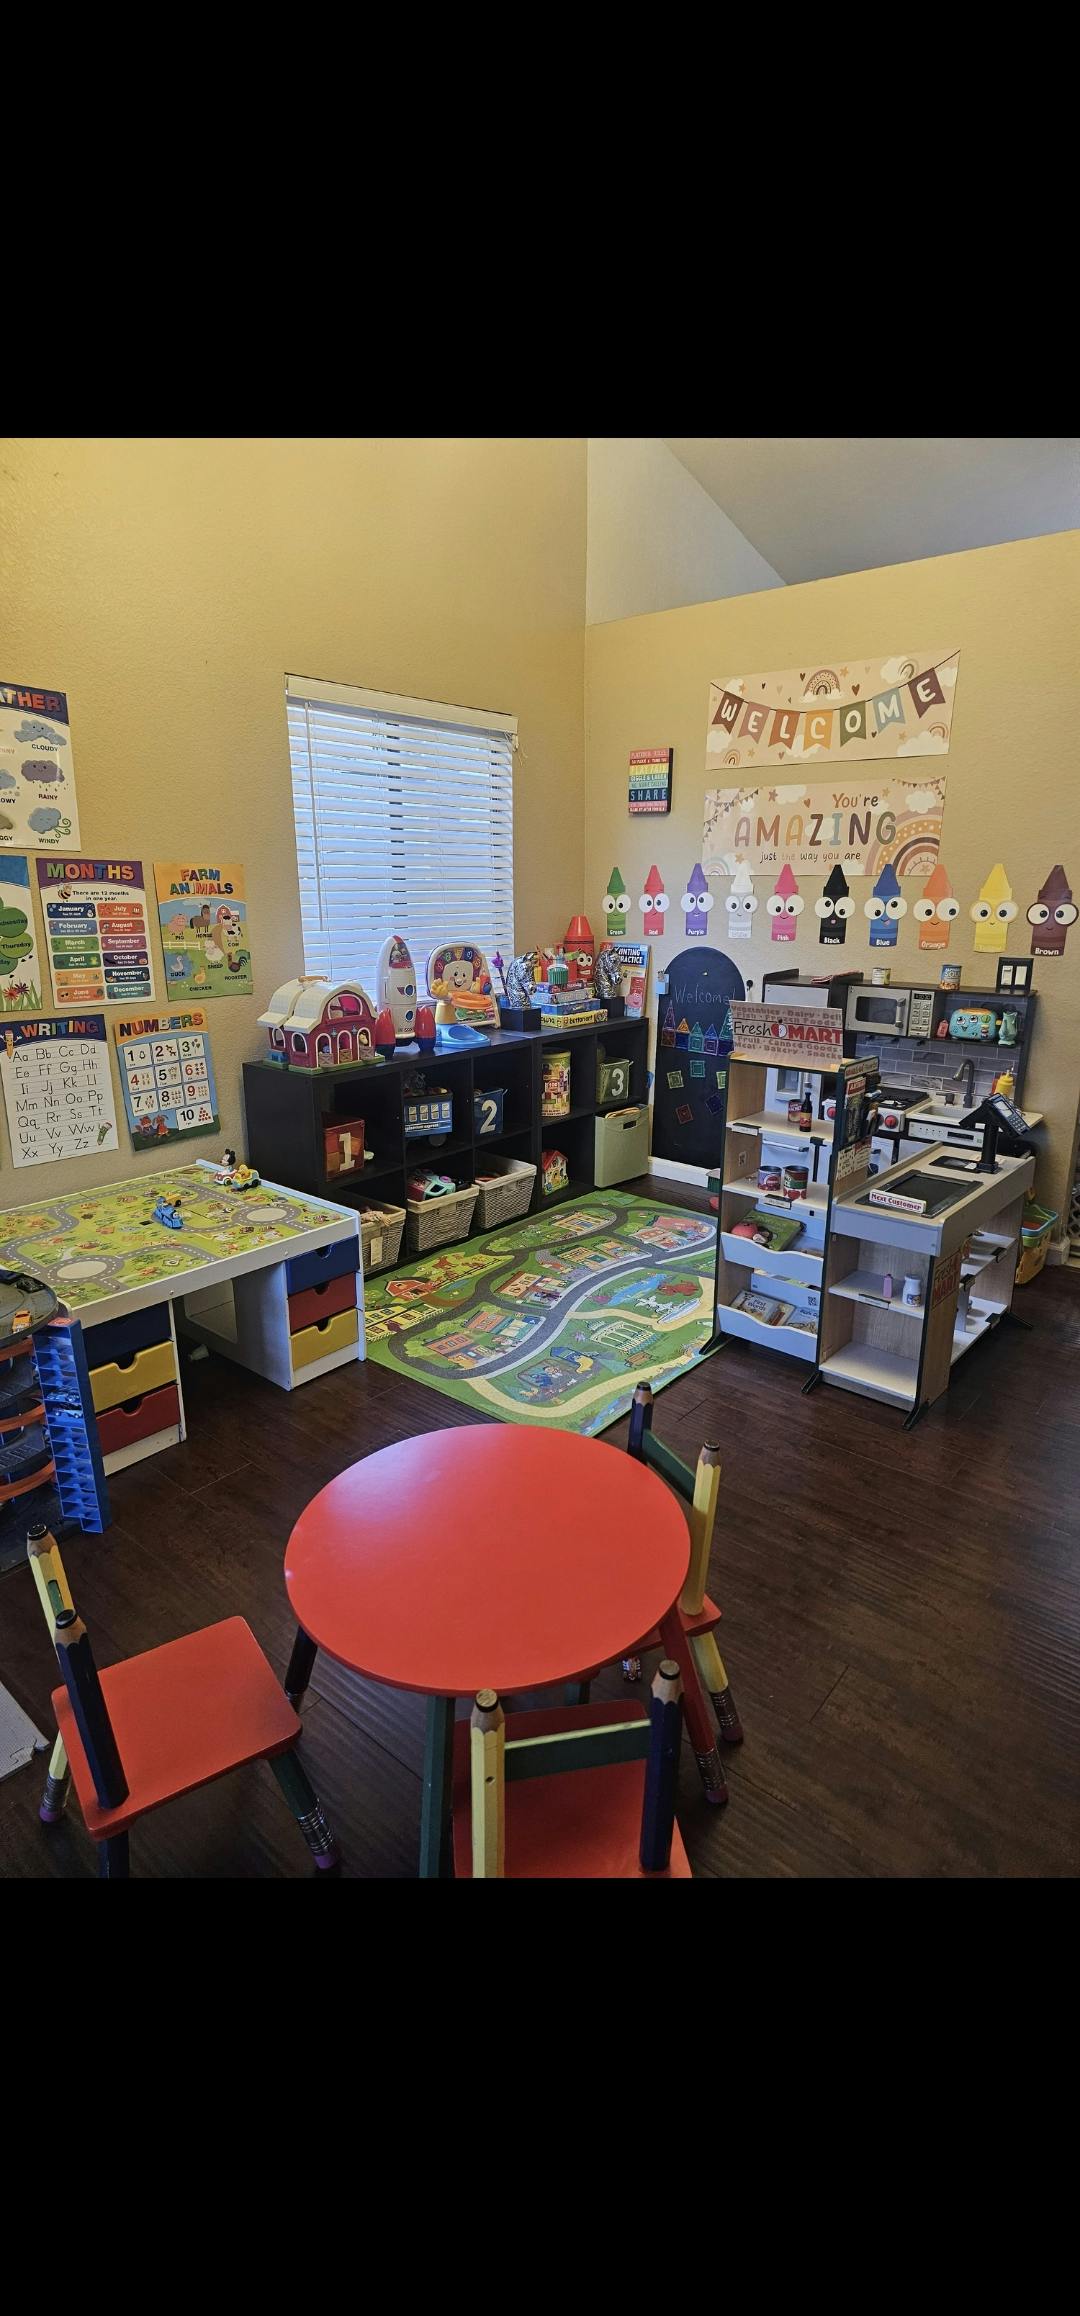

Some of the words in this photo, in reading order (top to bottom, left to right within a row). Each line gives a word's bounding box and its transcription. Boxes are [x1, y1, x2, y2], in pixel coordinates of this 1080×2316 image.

[0, 688, 61, 712] THER
[720, 677, 936, 739] WELCOME
[630, 789, 667, 800] SHARE
[832, 793, 879, 808] You're
[734, 810, 896, 847] AMAZING
[760, 852, 777, 864] just
[782, 852, 796, 860] the
[800, 852, 818, 863] way
[822, 852, 840, 863] you
[46, 863, 134, 880] MONTHS
[180, 868, 220, 882] FARM
[170, 882, 234, 895] ANIMALS
[921, 940, 946, 949] Orange
[1034, 947, 1059, 956] Brown
[731, 1005, 780, 1015] Vegetables
[788, 1010, 815, 1018] Dairy
[120, 1012, 204, 1037] NUMBERS
[765, 1014, 801, 1022] Frozen
[803, 1018, 836, 1026] Foods
[21, 1020, 98, 1038] WRITING
[734, 1022, 772, 1036] Fresh
[788, 1024, 842, 1044] MART
[155, 1046, 164, 1057] 2
[182, 1041, 190, 1052] 3
[764, 1045, 798, 1054] Bakery
[808, 1051, 842, 1059] Snacks
[769, 1038, 802, 1048] Canned
[806, 1043, 838, 1052] Goods
[13, 1051, 28, 1062] Aa
[36, 1048, 52, 1060] Bb
[58, 1046, 74, 1057] Cc
[80, 1044, 96, 1054] Dd
[128, 1050, 134, 1062] 1
[16, 1067, 30, 1078] Ee
[39, 1064, 52, 1076] Ff
[60, 1062, 78, 1075] Gg
[83, 1060, 98, 1070] Hh
[158, 1069, 167, 1081] 5
[185, 1064, 194, 1076] 6
[22, 1084, 28, 1094] Ii
[40, 1080, 53, 1095] Jj
[63, 1077, 78, 1088] Kk
[86, 1074, 96, 1085] Ll
[130, 1074, 140, 1086] 4
[612, 1068, 624, 1096] 3
[162, 1090, 170, 1102] 8
[187, 1086, 196, 1097] 9
[16, 1099, 38, 1112] Mm
[44, 1096, 60, 1108] Nn
[66, 1093, 82, 1104] Oo
[88, 1090, 104, 1104] Pp
[134, 1096, 142, 1108] 7
[18, 1116, 40, 1130] Qq
[46, 1112, 61, 1123] Rr
[70, 1108, 82, 1119] Ss
[89, 1106, 102, 1116] Tt
[180, 1110, 194, 1122] 10
[480, 1100, 498, 1134] 2
[20, 1132, 36, 1144] Uu
[46, 1128, 61, 1139] Vv
[69, 1123, 94, 1135] Ww
[22, 1148, 38, 1159] Xx
[49, 1143, 64, 1157] Yy
[74, 1138, 89, 1150] Zz
[338, 1132, 356, 1172] 1
[872, 1194, 886, 1202] Next
[888, 1198, 922, 1210] Customer
[748, 1302, 766, 1312] Words
[754, 1300, 767, 1308] First
